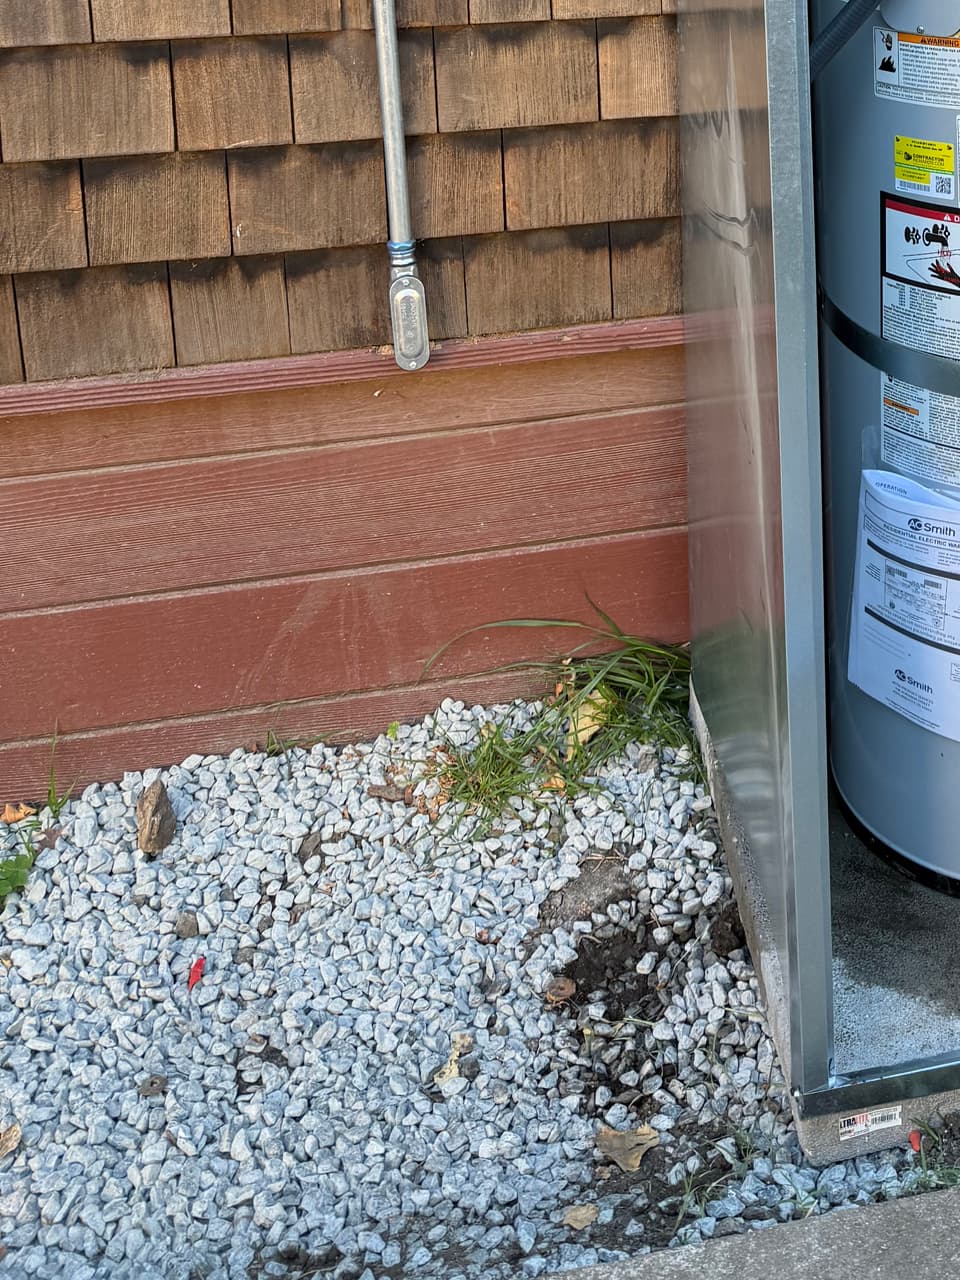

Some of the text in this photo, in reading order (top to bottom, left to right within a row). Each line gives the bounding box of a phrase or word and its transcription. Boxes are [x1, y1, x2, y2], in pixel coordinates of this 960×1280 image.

[926, 38, 960, 47] WARNING
[876, 482, 908, 496] OPERATION
[884, 523, 918, 541] RESIDENTIAL
[918, 535, 947, 547] ELECTRIC
[924, 522, 956, 537] Smith
[907, 676, 933, 694] Smith
